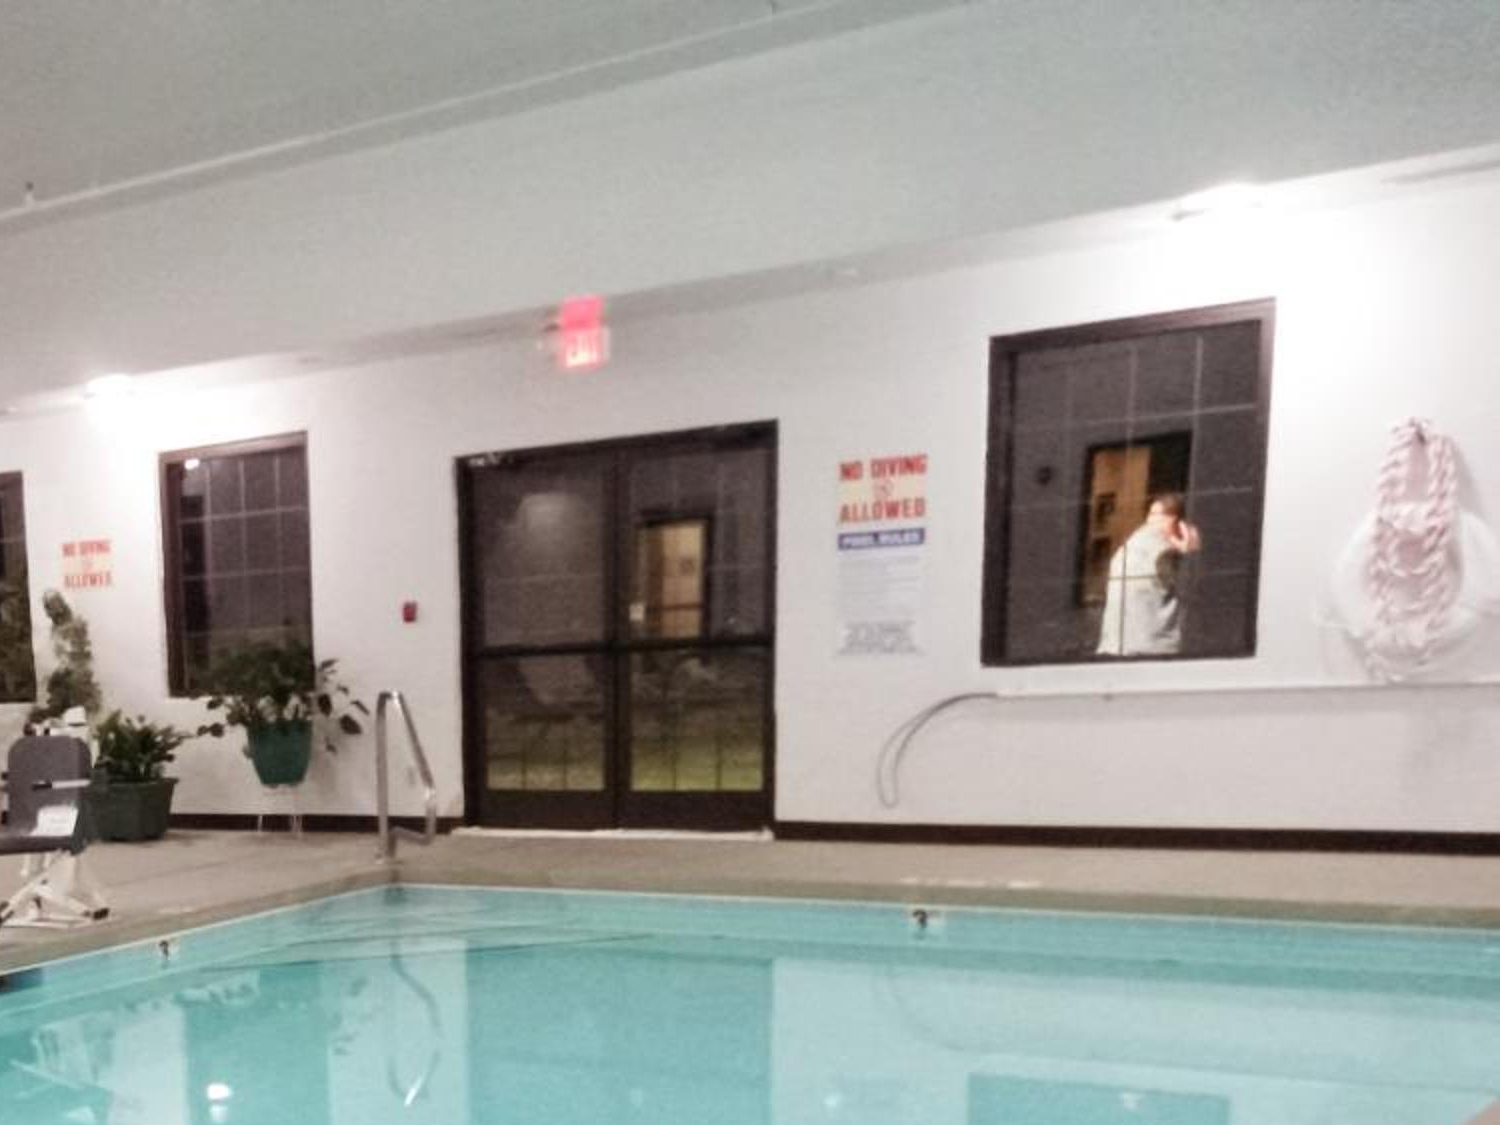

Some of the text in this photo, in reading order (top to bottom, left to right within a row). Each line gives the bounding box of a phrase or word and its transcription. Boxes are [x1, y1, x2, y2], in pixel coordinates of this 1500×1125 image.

[840, 454, 928, 481] NO DIVING
[839, 498, 926, 523] ALLOWED
